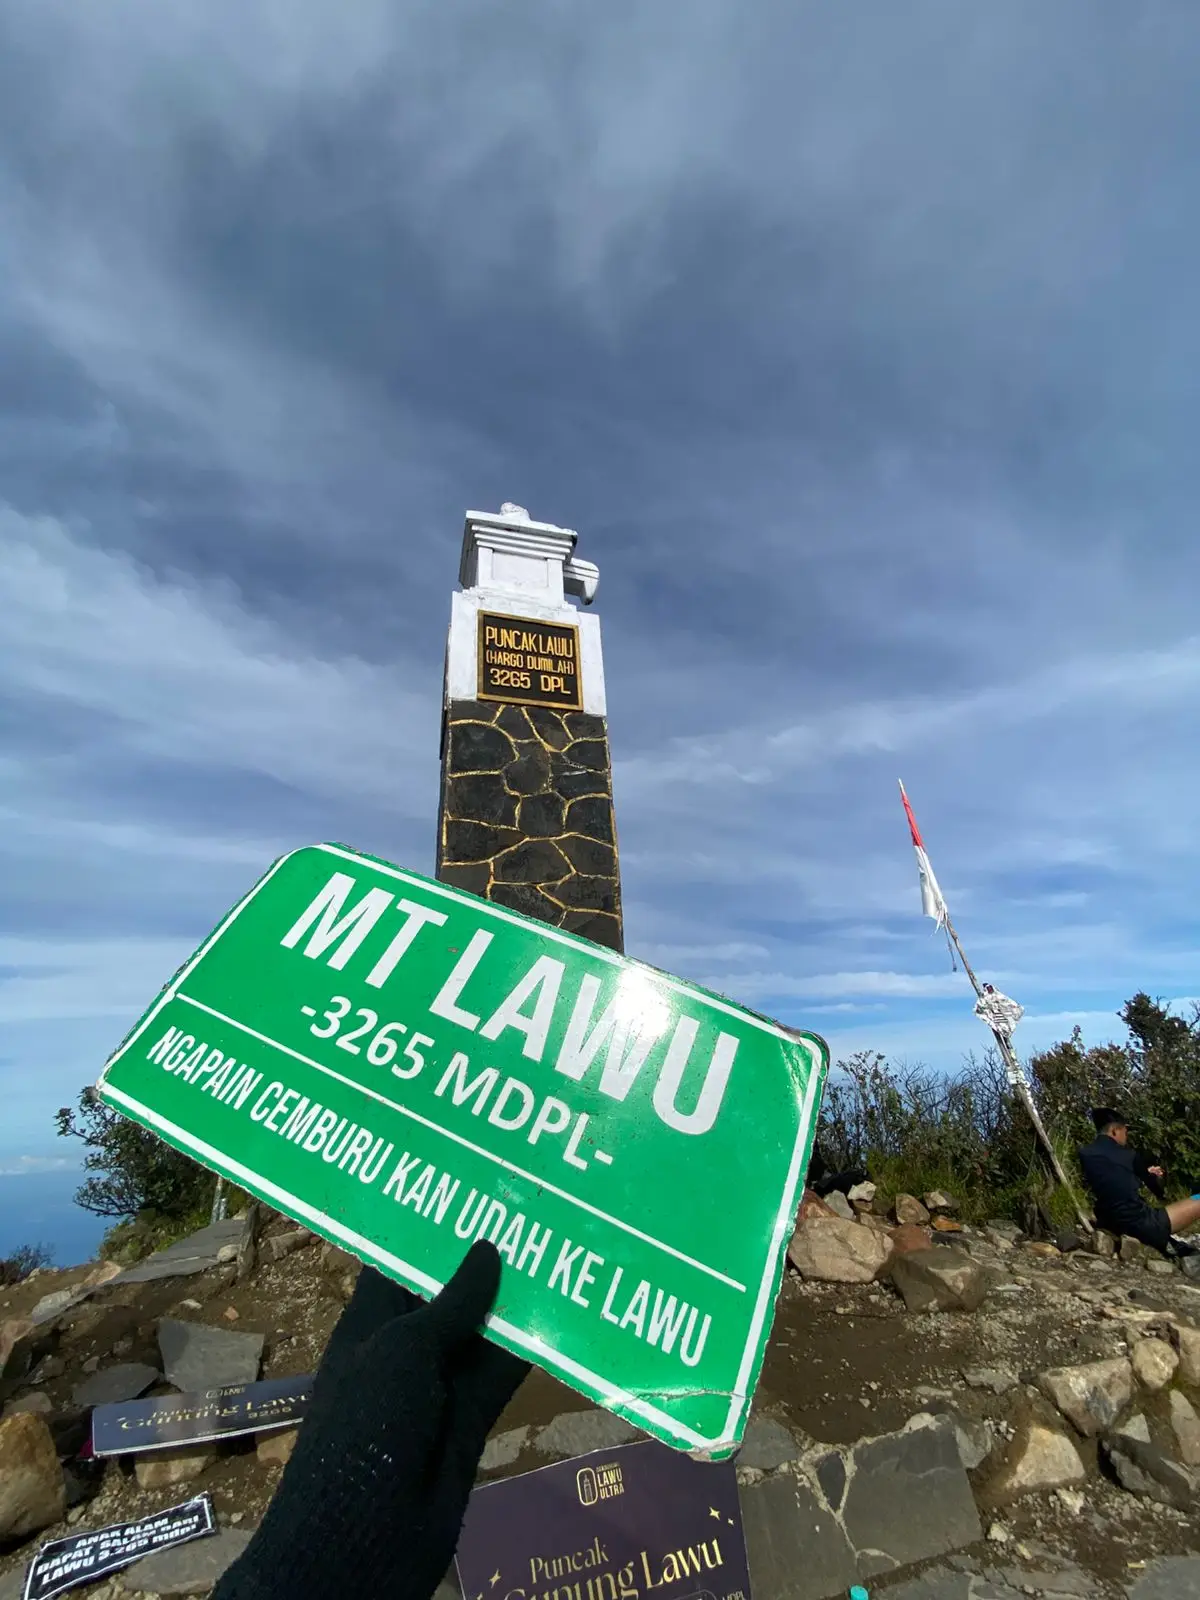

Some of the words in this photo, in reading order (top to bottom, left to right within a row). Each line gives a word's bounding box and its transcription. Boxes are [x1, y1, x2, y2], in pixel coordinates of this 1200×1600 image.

[486, 626, 537, 653] PUNCAK
[539, 634, 574, 658] LAWU
[486, 650, 524, 668] (HARGO
[490, 668, 531, 690] 3265
[540, 675, 572, 695] DPL
[280, 871, 449, 989] MT
[429, 928, 740, 1135] LAWU
[301, 995, 436, 1079] -3265
[434, 1051, 613, 1170] MDPL-
[146, 1026, 265, 1110] NGAPAIN
[250, 1081, 394, 1184] CEMBURU
[382, 1151, 461, 1225] KAN
[454, 1188, 553, 1278] UDAH
[547, 1238, 604, 1308] KE
[600, 1266, 712, 1367] LAWU
[597, 1467, 623, 1487] LAWU
[600, 1483, 625, 1500] ULTRA
[75, 1529, 121, 1549] ANAK
[124, 1517, 169, 1536] ALAM
[36, 1546, 94, 1576] DAPAT
[42, 1554, 95, 1586] LAWU
[529, 1536, 609, 1585] Puncak
[640, 1537, 724, 1590] Lawu
